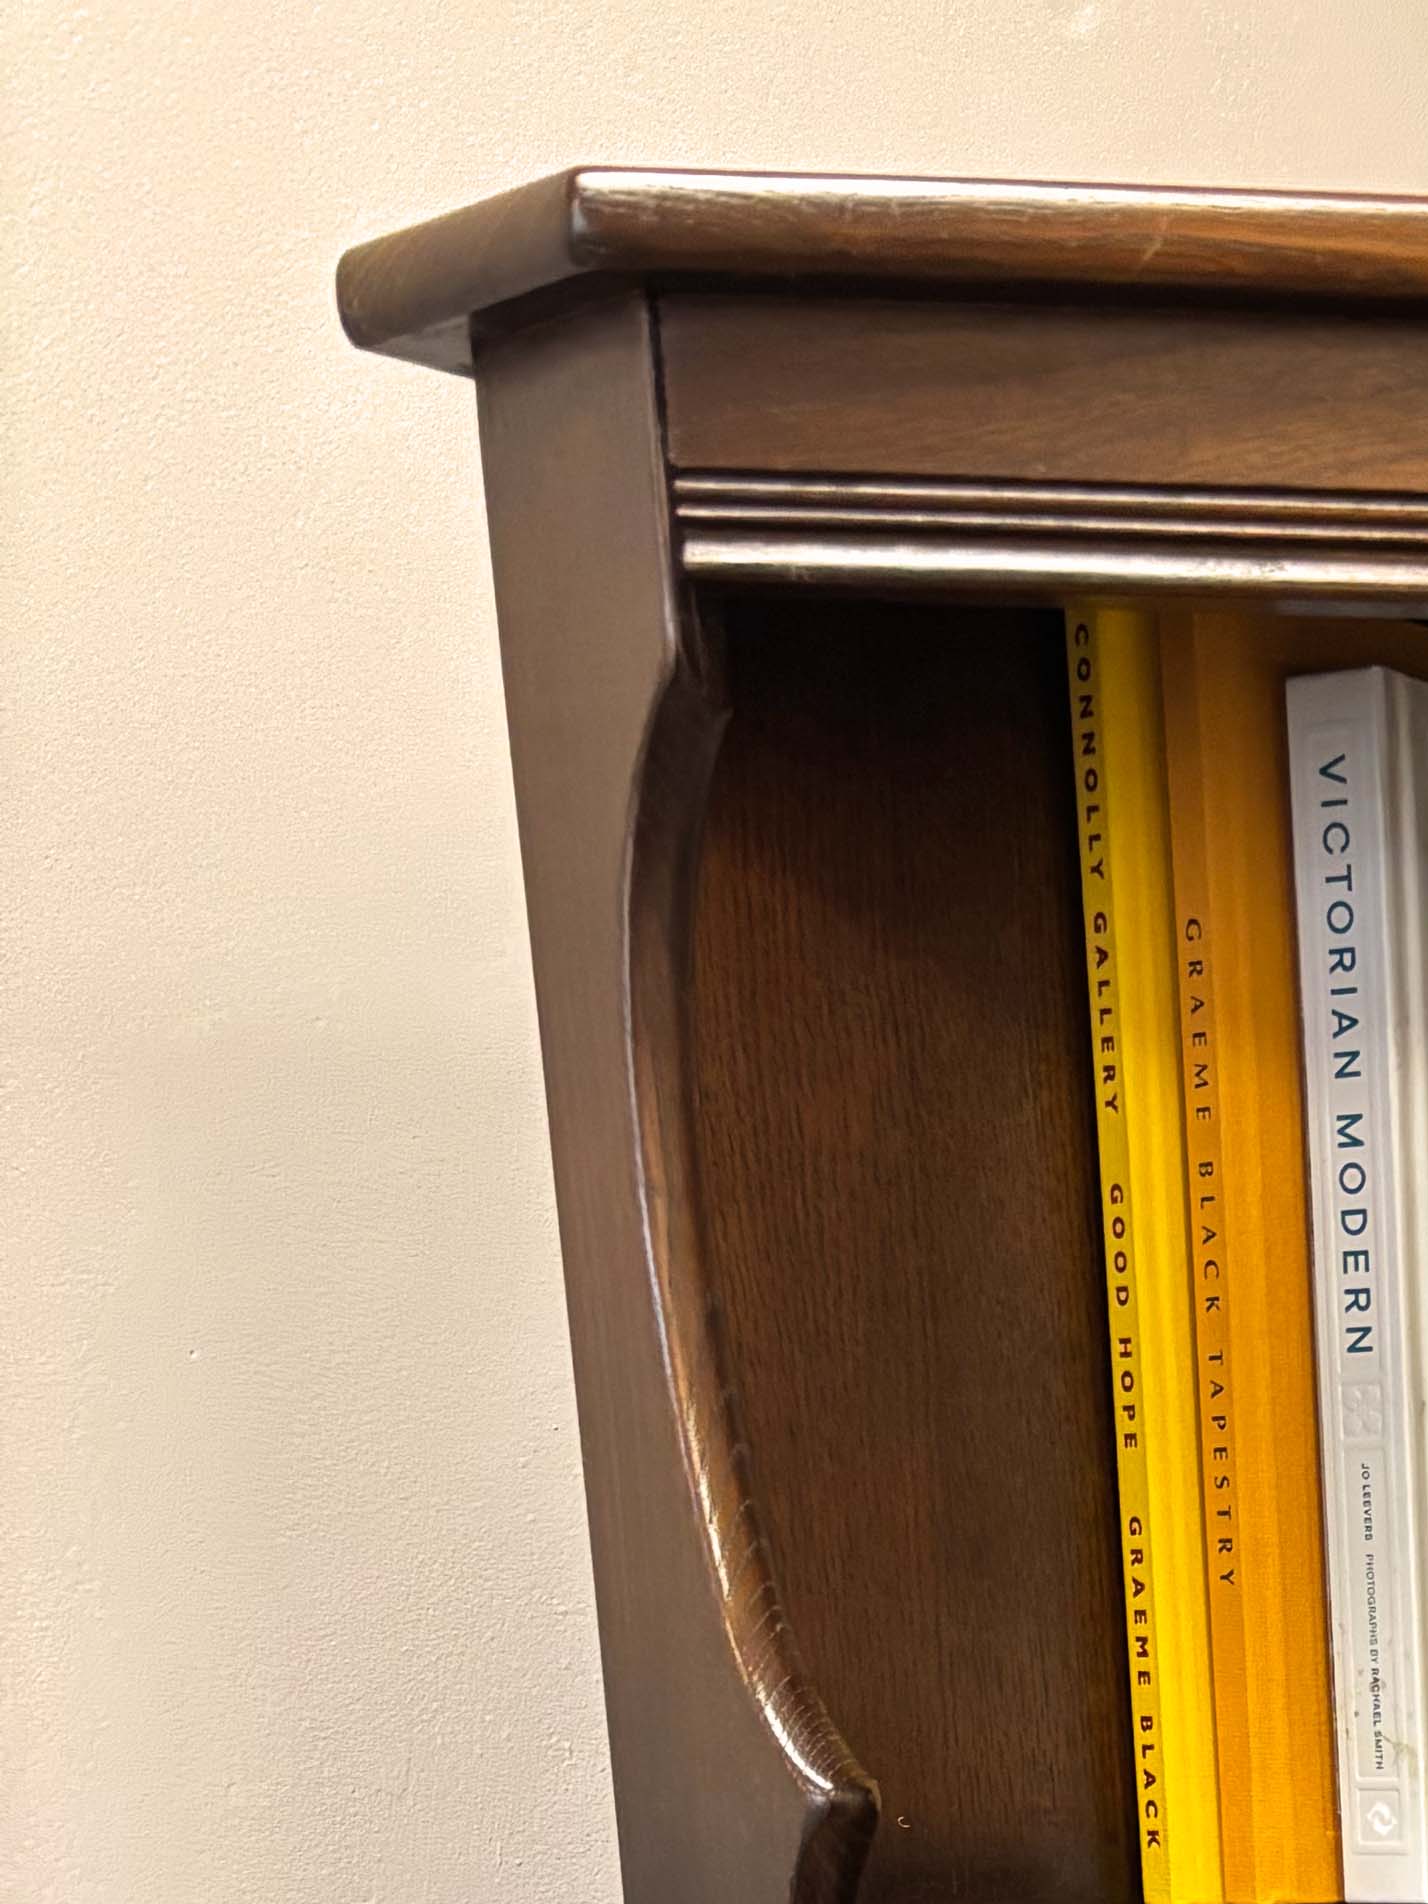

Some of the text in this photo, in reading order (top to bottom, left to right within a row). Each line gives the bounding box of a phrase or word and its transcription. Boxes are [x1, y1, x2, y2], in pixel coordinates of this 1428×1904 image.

[1074, 622, 1161, 1849] CONNOLLY GALLERY GOOD HOPE GRAEME BLACK
[1184, 917, 1236, 1586] GRAEME BLACK TAPESTRY
[1318, 752, 1374, 1354] VICTORIAN MODERN
[1361, 1463, 1371, 1480] JO
